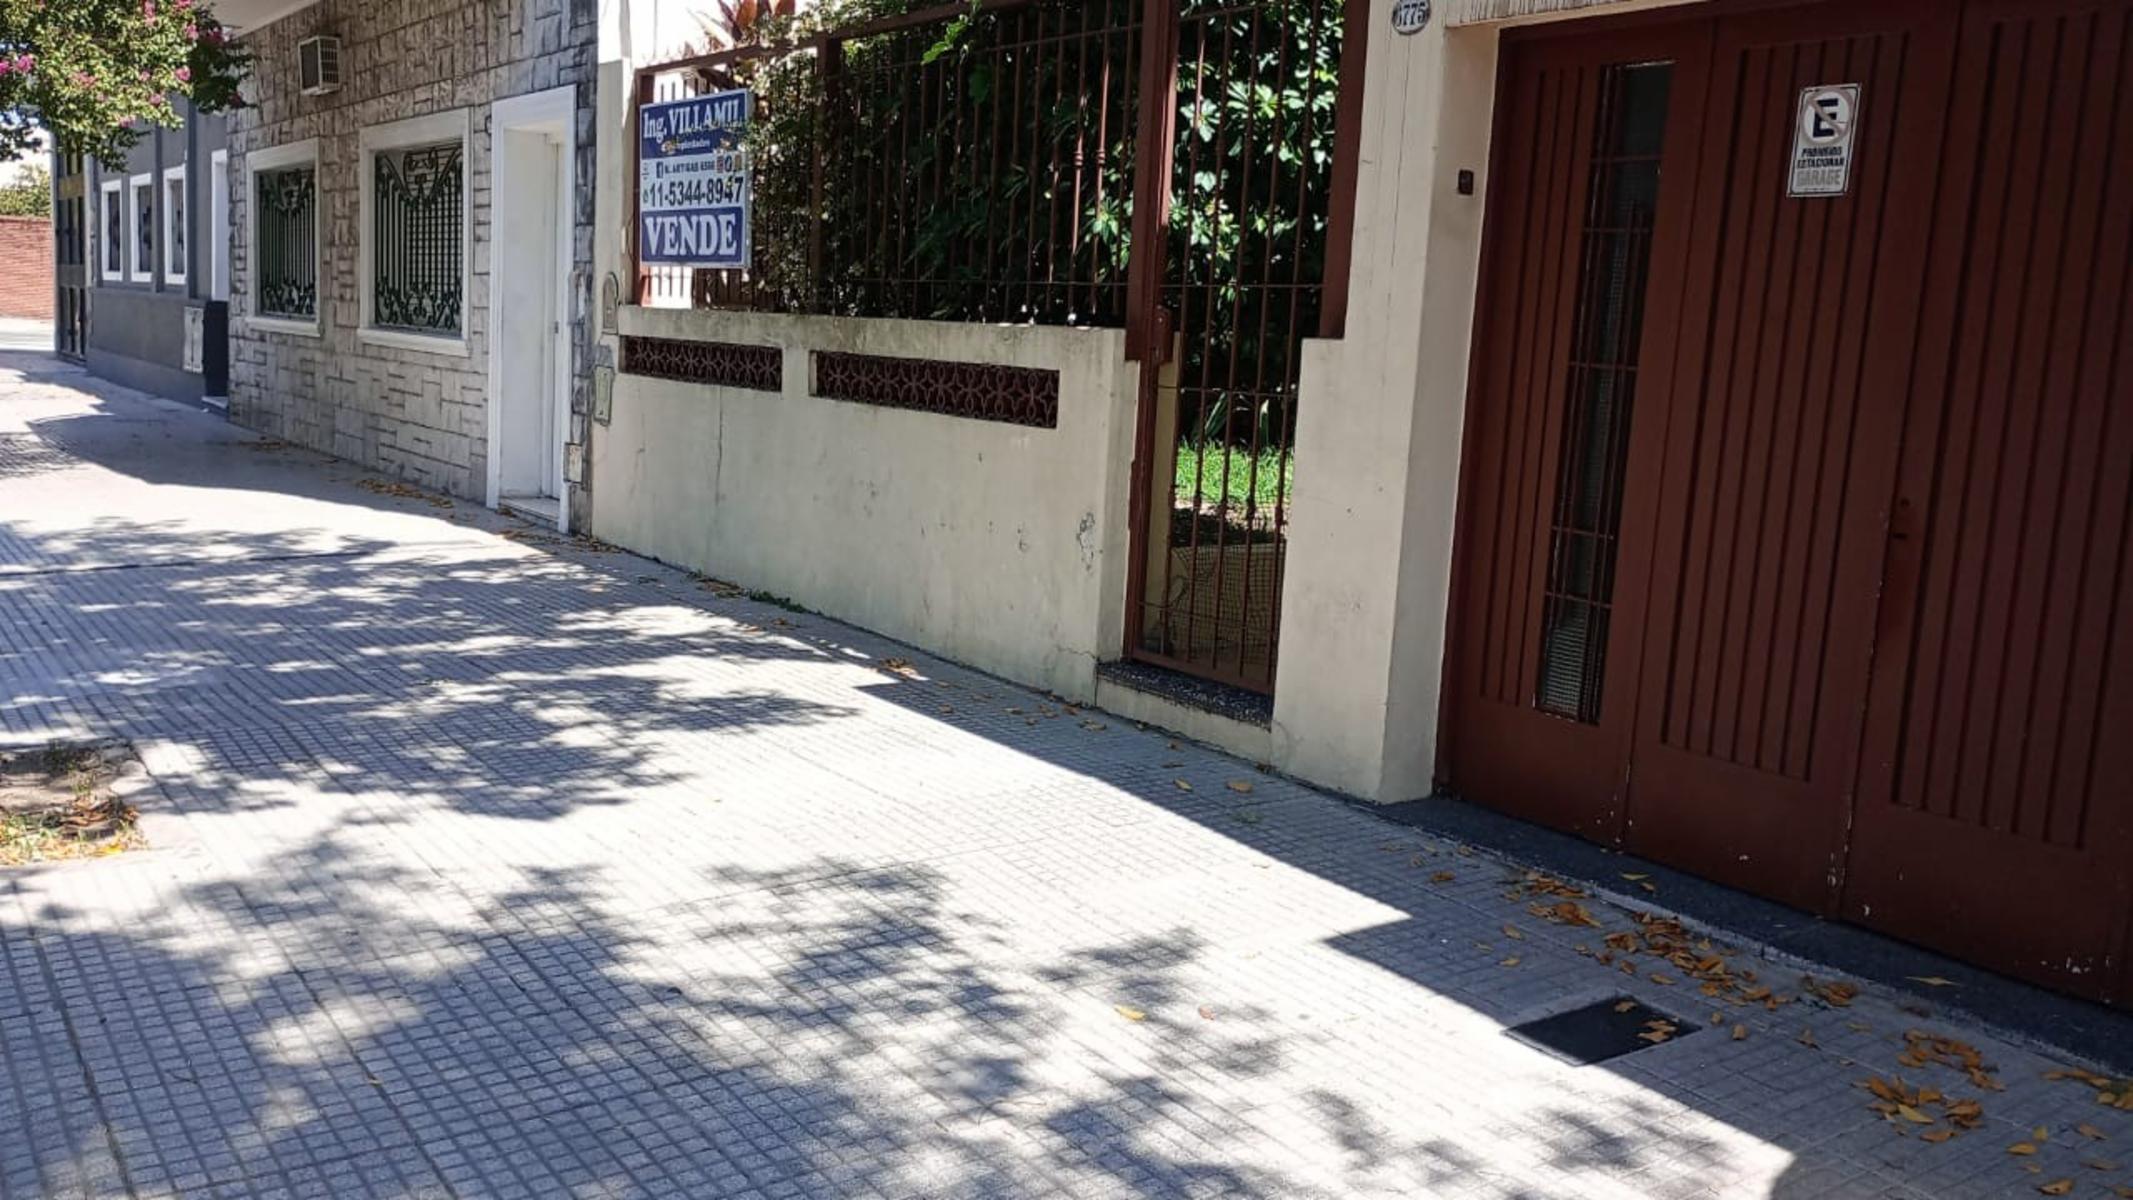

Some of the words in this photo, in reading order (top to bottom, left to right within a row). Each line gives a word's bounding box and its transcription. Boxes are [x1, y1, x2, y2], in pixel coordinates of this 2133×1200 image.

[643, 112, 667, 144] Ing.
[668, 99, 742, 135] VILLAMIL
[1796, 169, 1842, 187] GARAGE
[644, 213, 737, 256] VENDE
